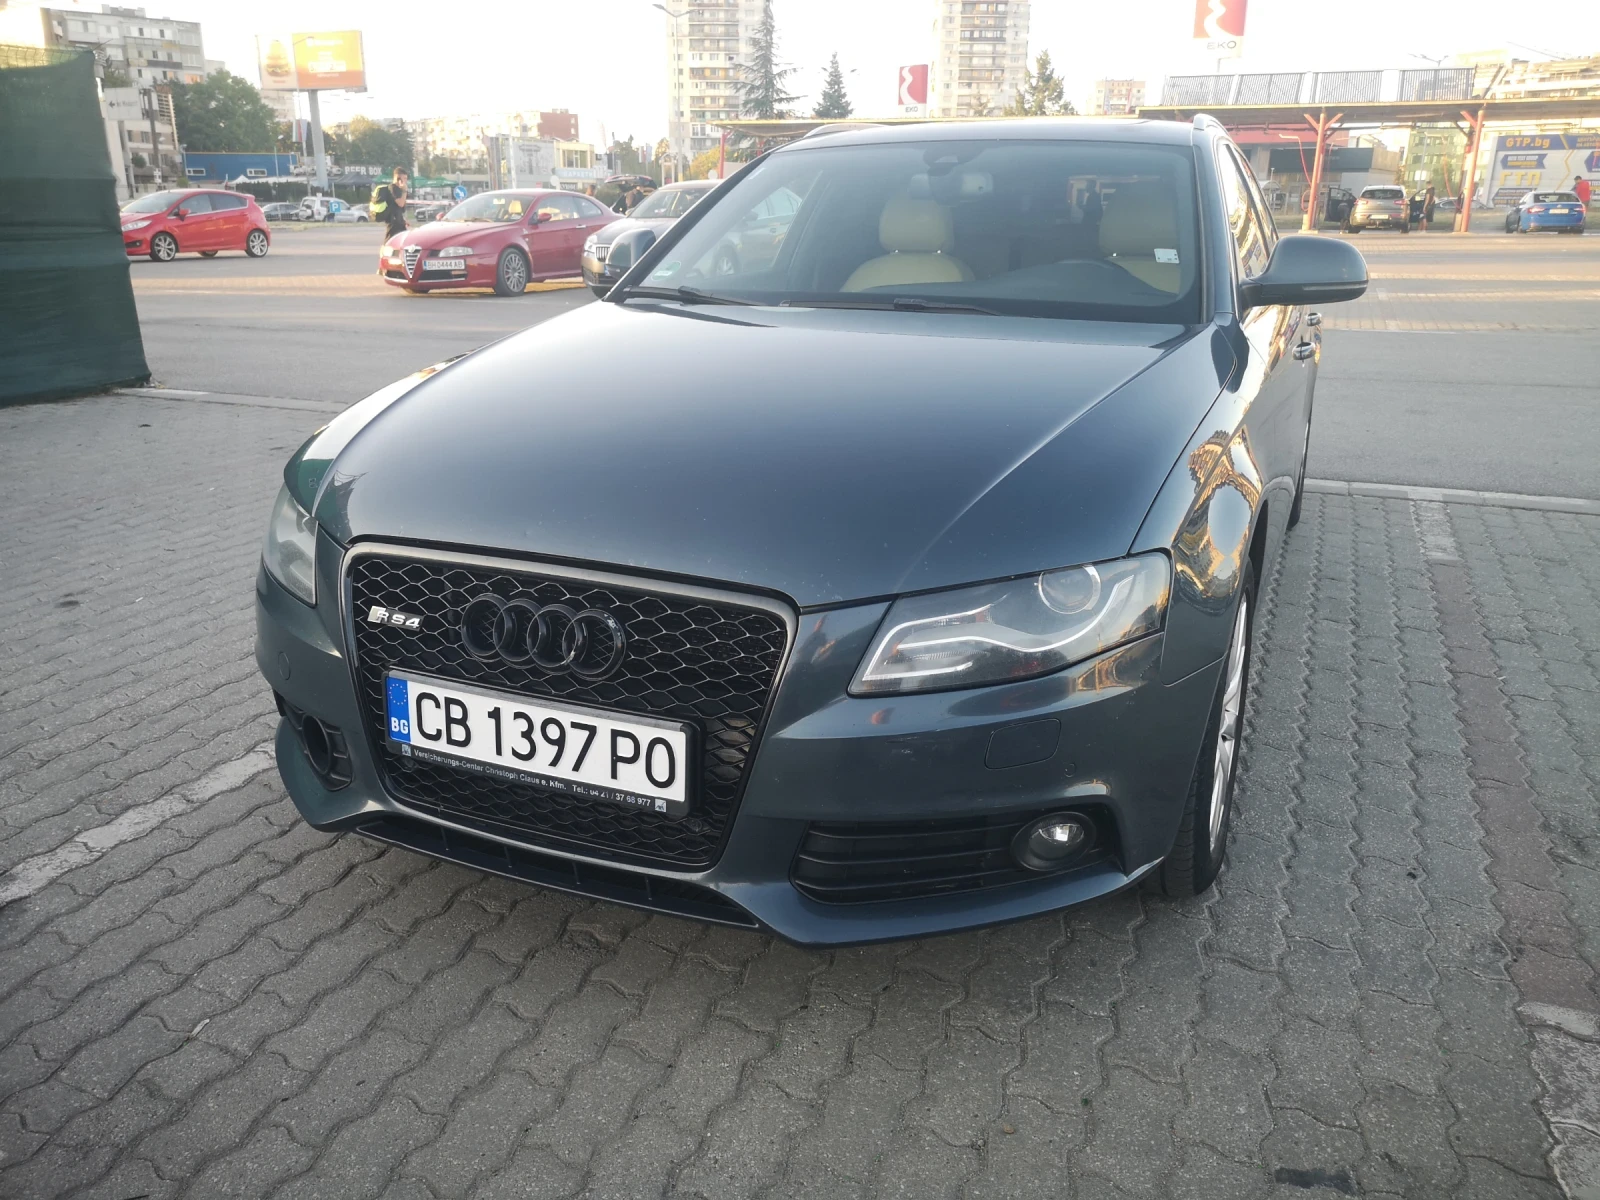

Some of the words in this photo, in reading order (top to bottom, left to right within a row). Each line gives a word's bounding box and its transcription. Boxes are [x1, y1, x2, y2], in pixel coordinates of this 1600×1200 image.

[1207, 40, 1236, 50] EKO
[1505, 136, 1551, 149] GTP.bg
[369, 166, 382, 175] BOX
[332, 203, 339, 212] P
[390, 716, 409, 735] BG
[415, 691, 472, 748] CB
[487, 706, 598, 773] 1397
[414, 748, 483, 772] Versicherungs-Center
[484, 766, 518, 780] Christoph
[519, 773, 540, 785] Claus
[549, 779, 567, 790] Kfm.
[571, 784, 588, 795] Tel.:
[615, 792, 624, 801] 37
[637, 797, 651, 807] 977
